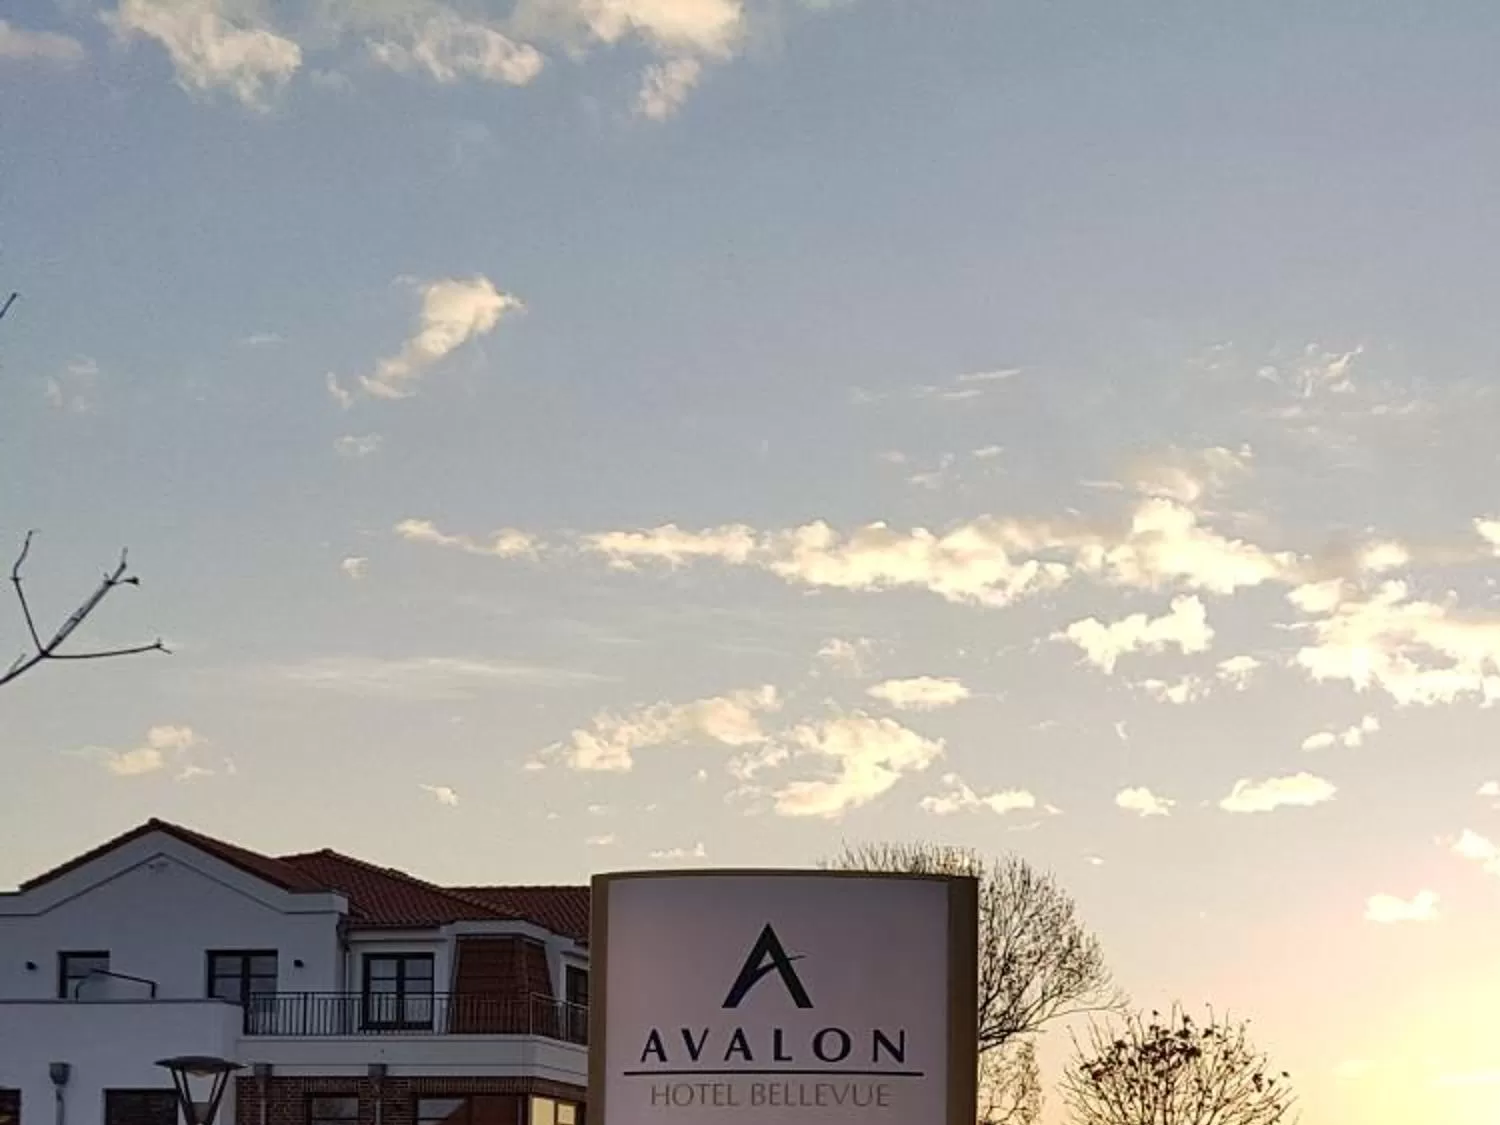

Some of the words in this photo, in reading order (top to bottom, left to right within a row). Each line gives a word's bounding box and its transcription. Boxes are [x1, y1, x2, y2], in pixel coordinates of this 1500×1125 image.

[639, 1027, 906, 1063] AVALON
[650, 1082, 741, 1107] HOTEL
[750, 1082, 893, 1108] BELLEVUE
